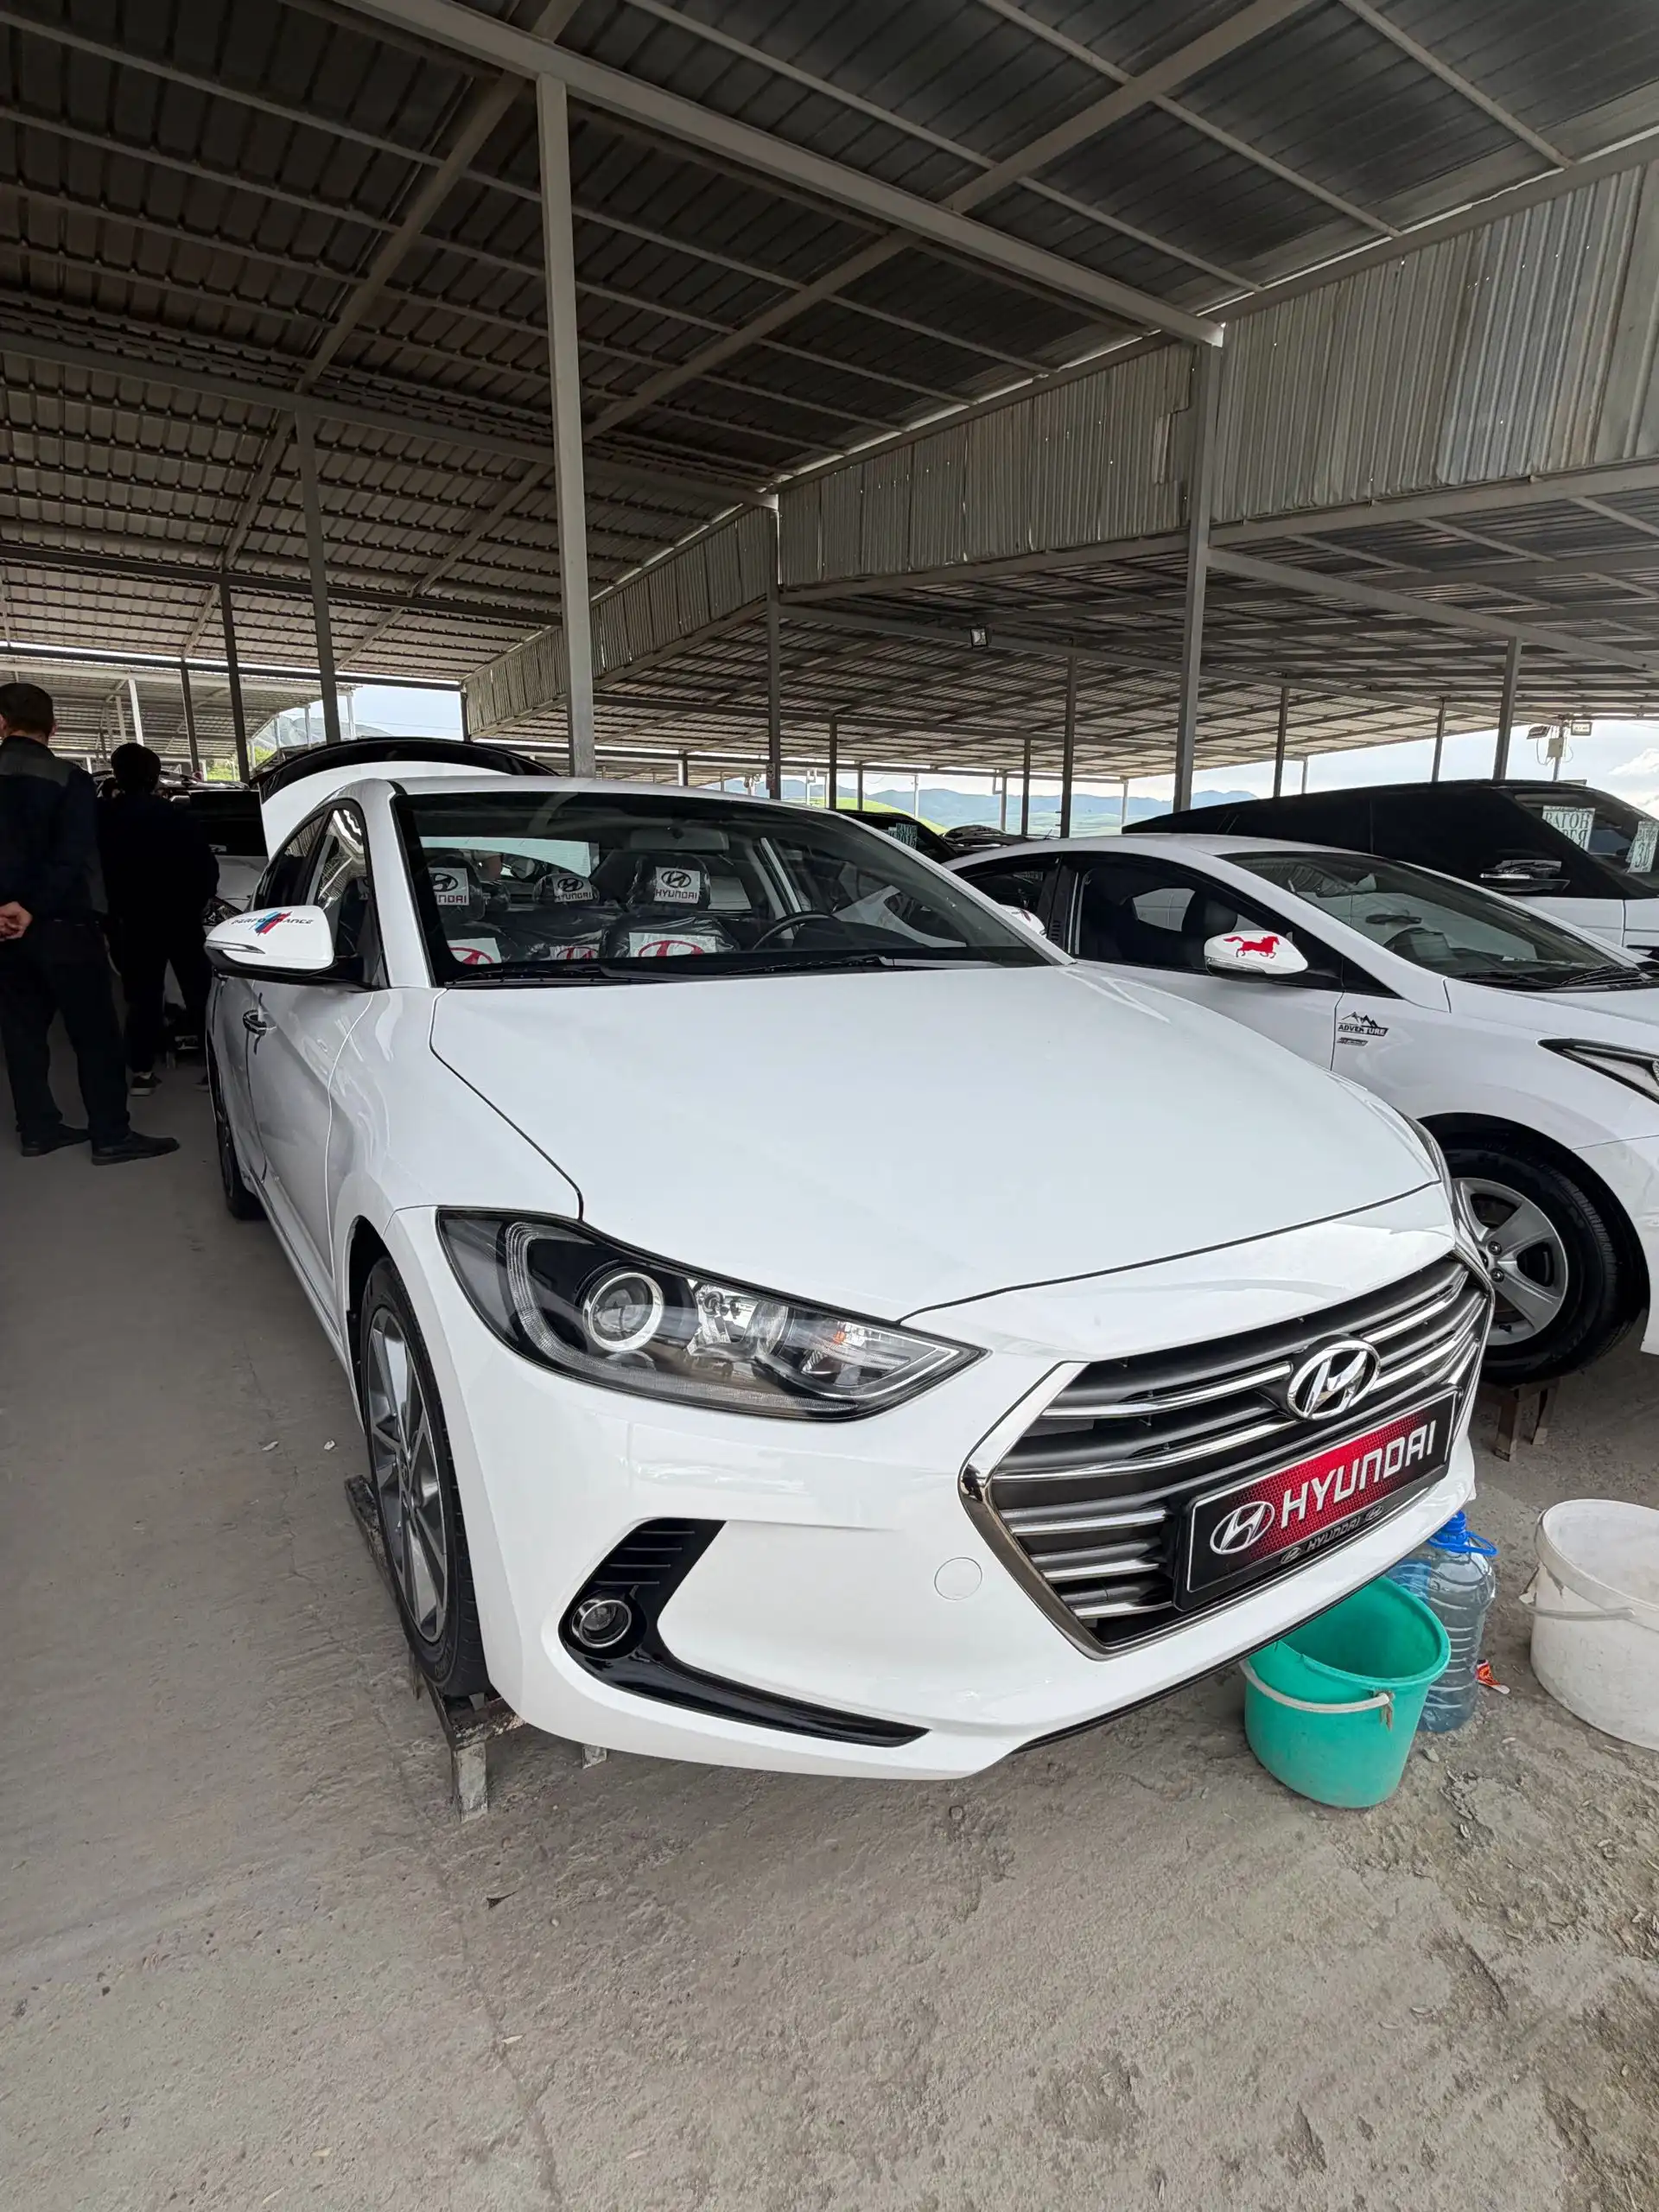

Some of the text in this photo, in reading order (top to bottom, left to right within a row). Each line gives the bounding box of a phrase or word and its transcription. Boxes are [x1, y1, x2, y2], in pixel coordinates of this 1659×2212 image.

[437, 894, 467, 904] NDAI
[656, 889, 698, 899] HYUNDAI
[231, 917, 315, 925] PERFOMANCE
[1338, 1024, 1386, 1035] ADVENTURE
[1281, 1420, 1437, 1529] HYUNDAI
[1306, 1516, 1361, 1552] HYUNDAI
